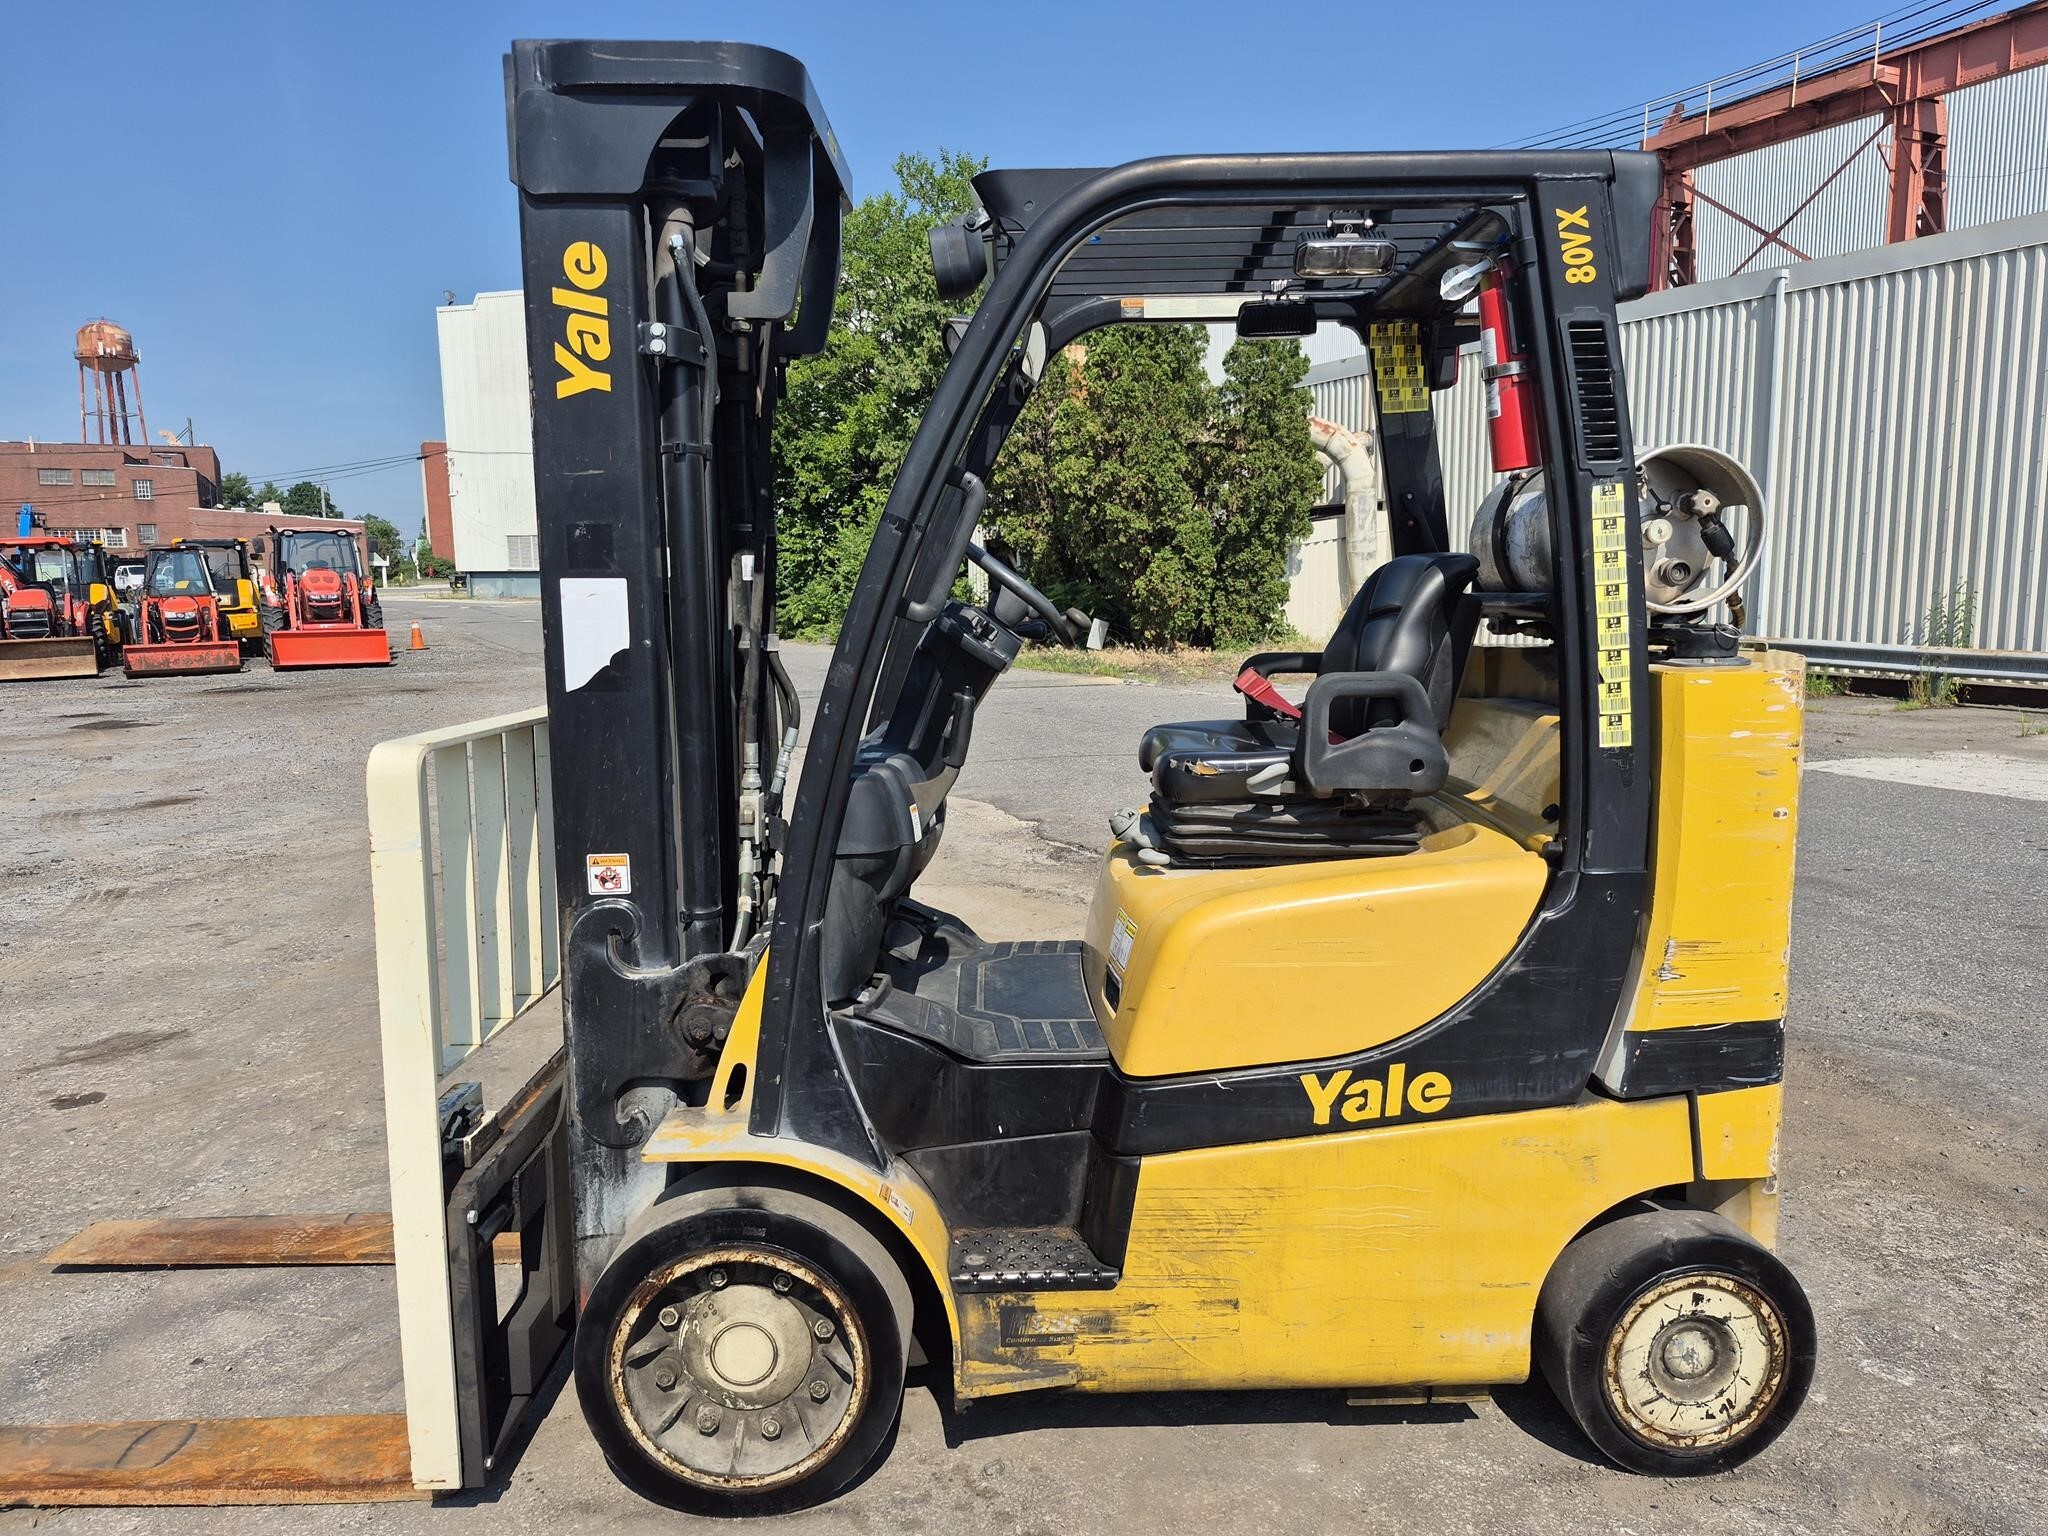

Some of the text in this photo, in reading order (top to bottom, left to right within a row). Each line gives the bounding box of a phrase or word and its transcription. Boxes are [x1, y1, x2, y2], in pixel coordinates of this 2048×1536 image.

[1556, 205, 1597, 284] 80VX
[552, 241, 612, 400] Yale
[1300, 1063, 1452, 1125] Yale
